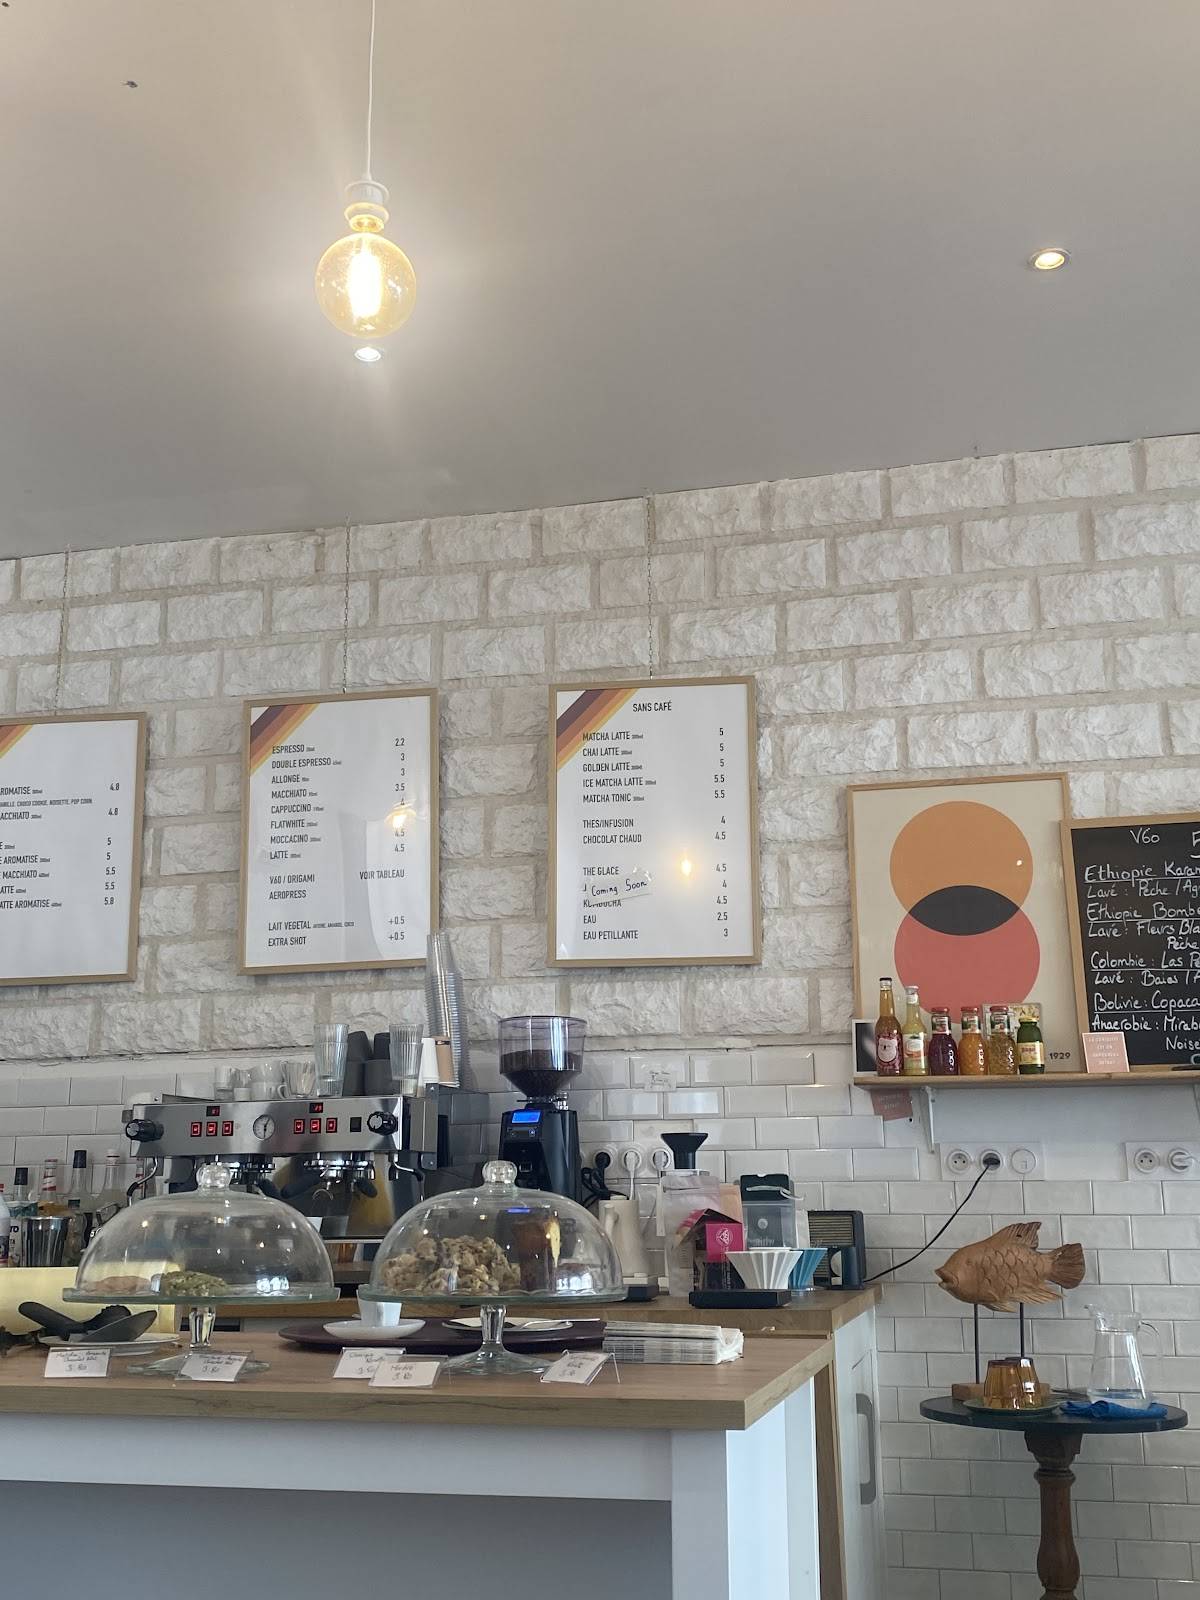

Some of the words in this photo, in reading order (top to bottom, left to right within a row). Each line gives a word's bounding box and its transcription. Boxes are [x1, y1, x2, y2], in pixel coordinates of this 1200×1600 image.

[633, 703, 652, 712] SANS
[654, 701, 672, 711] CAFÉ
[583, 732, 609, 741] MATCHA
[611, 731, 630, 740] LATTE
[719, 728, 724, 736] 5
[272, 744, 305, 754] ESPRESSO
[395, 738, 405, 746] 2.2
[583, 748, 598, 756] CHAI
[600, 747, 619, 756] LATTE
[720, 743, 724, 751] 5
[272, 760, 297, 769] DOUBLE
[299, 758, 331, 767] ESPRESSO
[401, 753, 405, 761] 3
[583, 763, 609, 772] GOLDEN
[611, 762, 630, 771] LATTE
[720, 759, 724, 767] 5
[272, 775, 300, 784] ALLONGE
[401, 768, 405, 776] 3
[583, 779, 593, 788] ICE
[595, 778, 622, 787] MATCHA
[624, 777, 643, 786] LATTE
[714, 774, 725, 783] 5.5
[110, 783, 120, 791] 4.8
[272, 789, 307, 799] MACCHIATO
[395, 783, 405, 791] 3.5
[583, 794, 609, 803] MATCHA
[612, 793, 631, 802] TONIC
[714, 790, 725, 798] 5.5
[0, 812, 29, 820] ACCHIATO
[108, 807, 118, 816] 4.8
[271, 804, 311, 814] CAPPUCCINO
[270, 819, 305, 829] FLATWHITE
[583, 818, 634, 828] THES/INFUSION
[721, 816, 726, 824] 4
[107, 837, 112, 845] 5
[270, 834, 308, 844] MOCCACINO
[583, 835, 617, 844] CHOCOLAT
[619, 834, 642, 843] CHAUD
[715, 832, 726, 840] 4.5
[3, 855, 38, 864] AROMATISE
[107, 852, 111, 860] 5
[270, 851, 288, 859] LATTE
[395, 844, 405, 852] 4.5
[2, 870, 38, 879] MACCHIATO
[106, 867, 116, 875] 5.5
[270, 876, 282, 884] V60
[287, 874, 315, 883] ORIGAMI
[360, 871, 375, 880] VOIR
[377, 869, 404, 879] TABLEAU
[583, 867, 595, 876] THE
[597, 867, 620, 875] GLACE
[716, 864, 727, 872] 4.5
[0, 886, 15, 894] ATTE
[105, 882, 115, 890] 5.5
[592, 885, 618, 896] Coming
[625, 878, 647, 891] Soon
[722, 880, 727, 888] 4
[269, 890, 307, 900] AEROPRESS
[1087, 884, 1118, 899] Lavé
[14, 900, 50, 908] AROMATISE
[716, 896, 727, 904] 4.5
[583, 915, 597, 924] EAU
[717, 912, 728, 921] 2.5
[1087, 902, 1142, 927] Ethiopie
[268, 922, 282, 931] LAIT
[284, 921, 311, 930] VEGETAL
[388, 916, 405, 925] +0.5
[1137, 921, 1174, 936] Fleurs
[268, 937, 288, 947] EXTRA
[290, 936, 307, 945] SHOT
[388, 932, 405, 941] +0.5
[583, 931, 597, 940] EAU
[599, 930, 638, 940] PETILLANTE
[724, 929, 728, 937] 3
[1091, 951, 1147, 969] Colombie
[1161, 951, 1183, 969] Las
[1094, 972, 1124, 985] Lavé
[1141, 970, 1178, 986] Baies
[1092, 1014, 1152, 1031] Anaerobie
